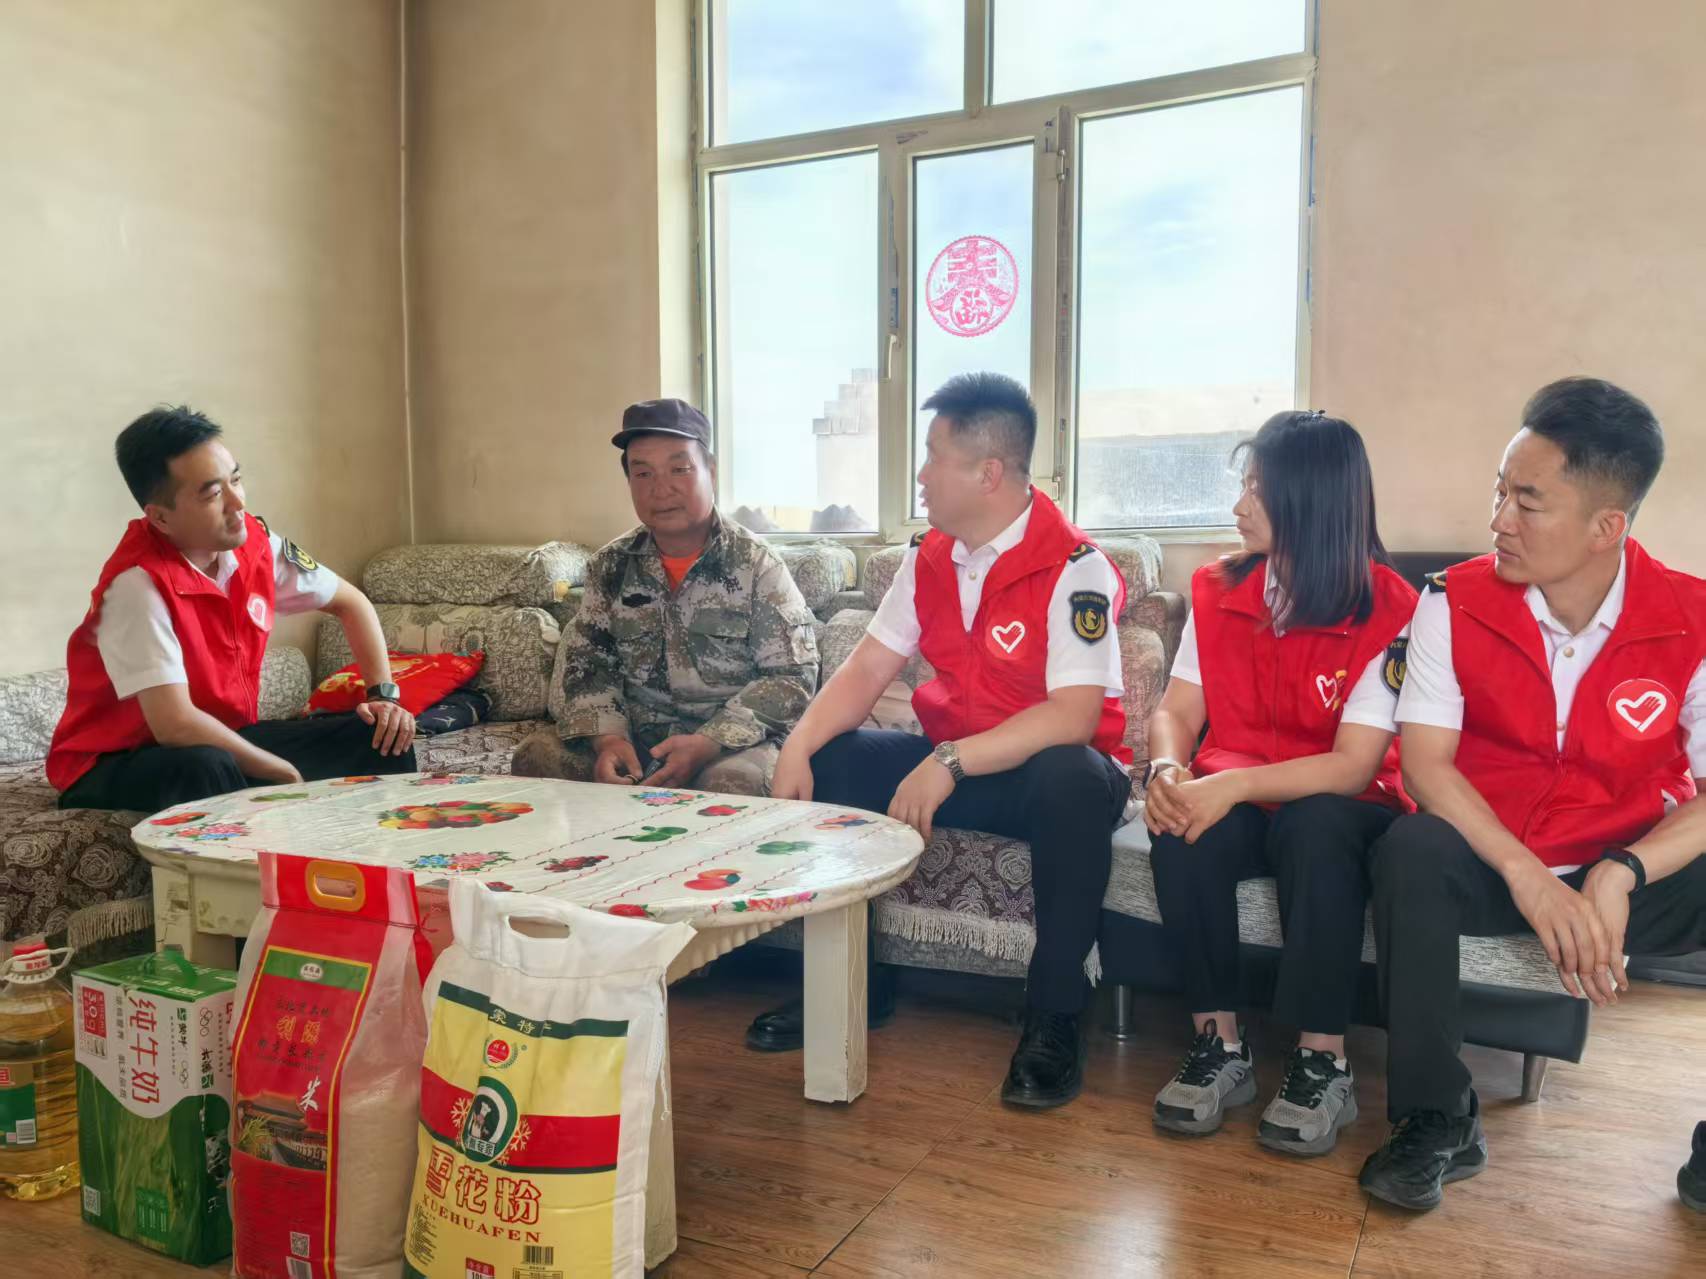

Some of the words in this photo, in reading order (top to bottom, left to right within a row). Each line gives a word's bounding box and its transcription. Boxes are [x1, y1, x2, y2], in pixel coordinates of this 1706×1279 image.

[128, 996, 160, 1104] 纯牛奶
[178, 1022, 188, 1048] 蒙牛
[425, 1145, 542, 1225] 雪花粉
